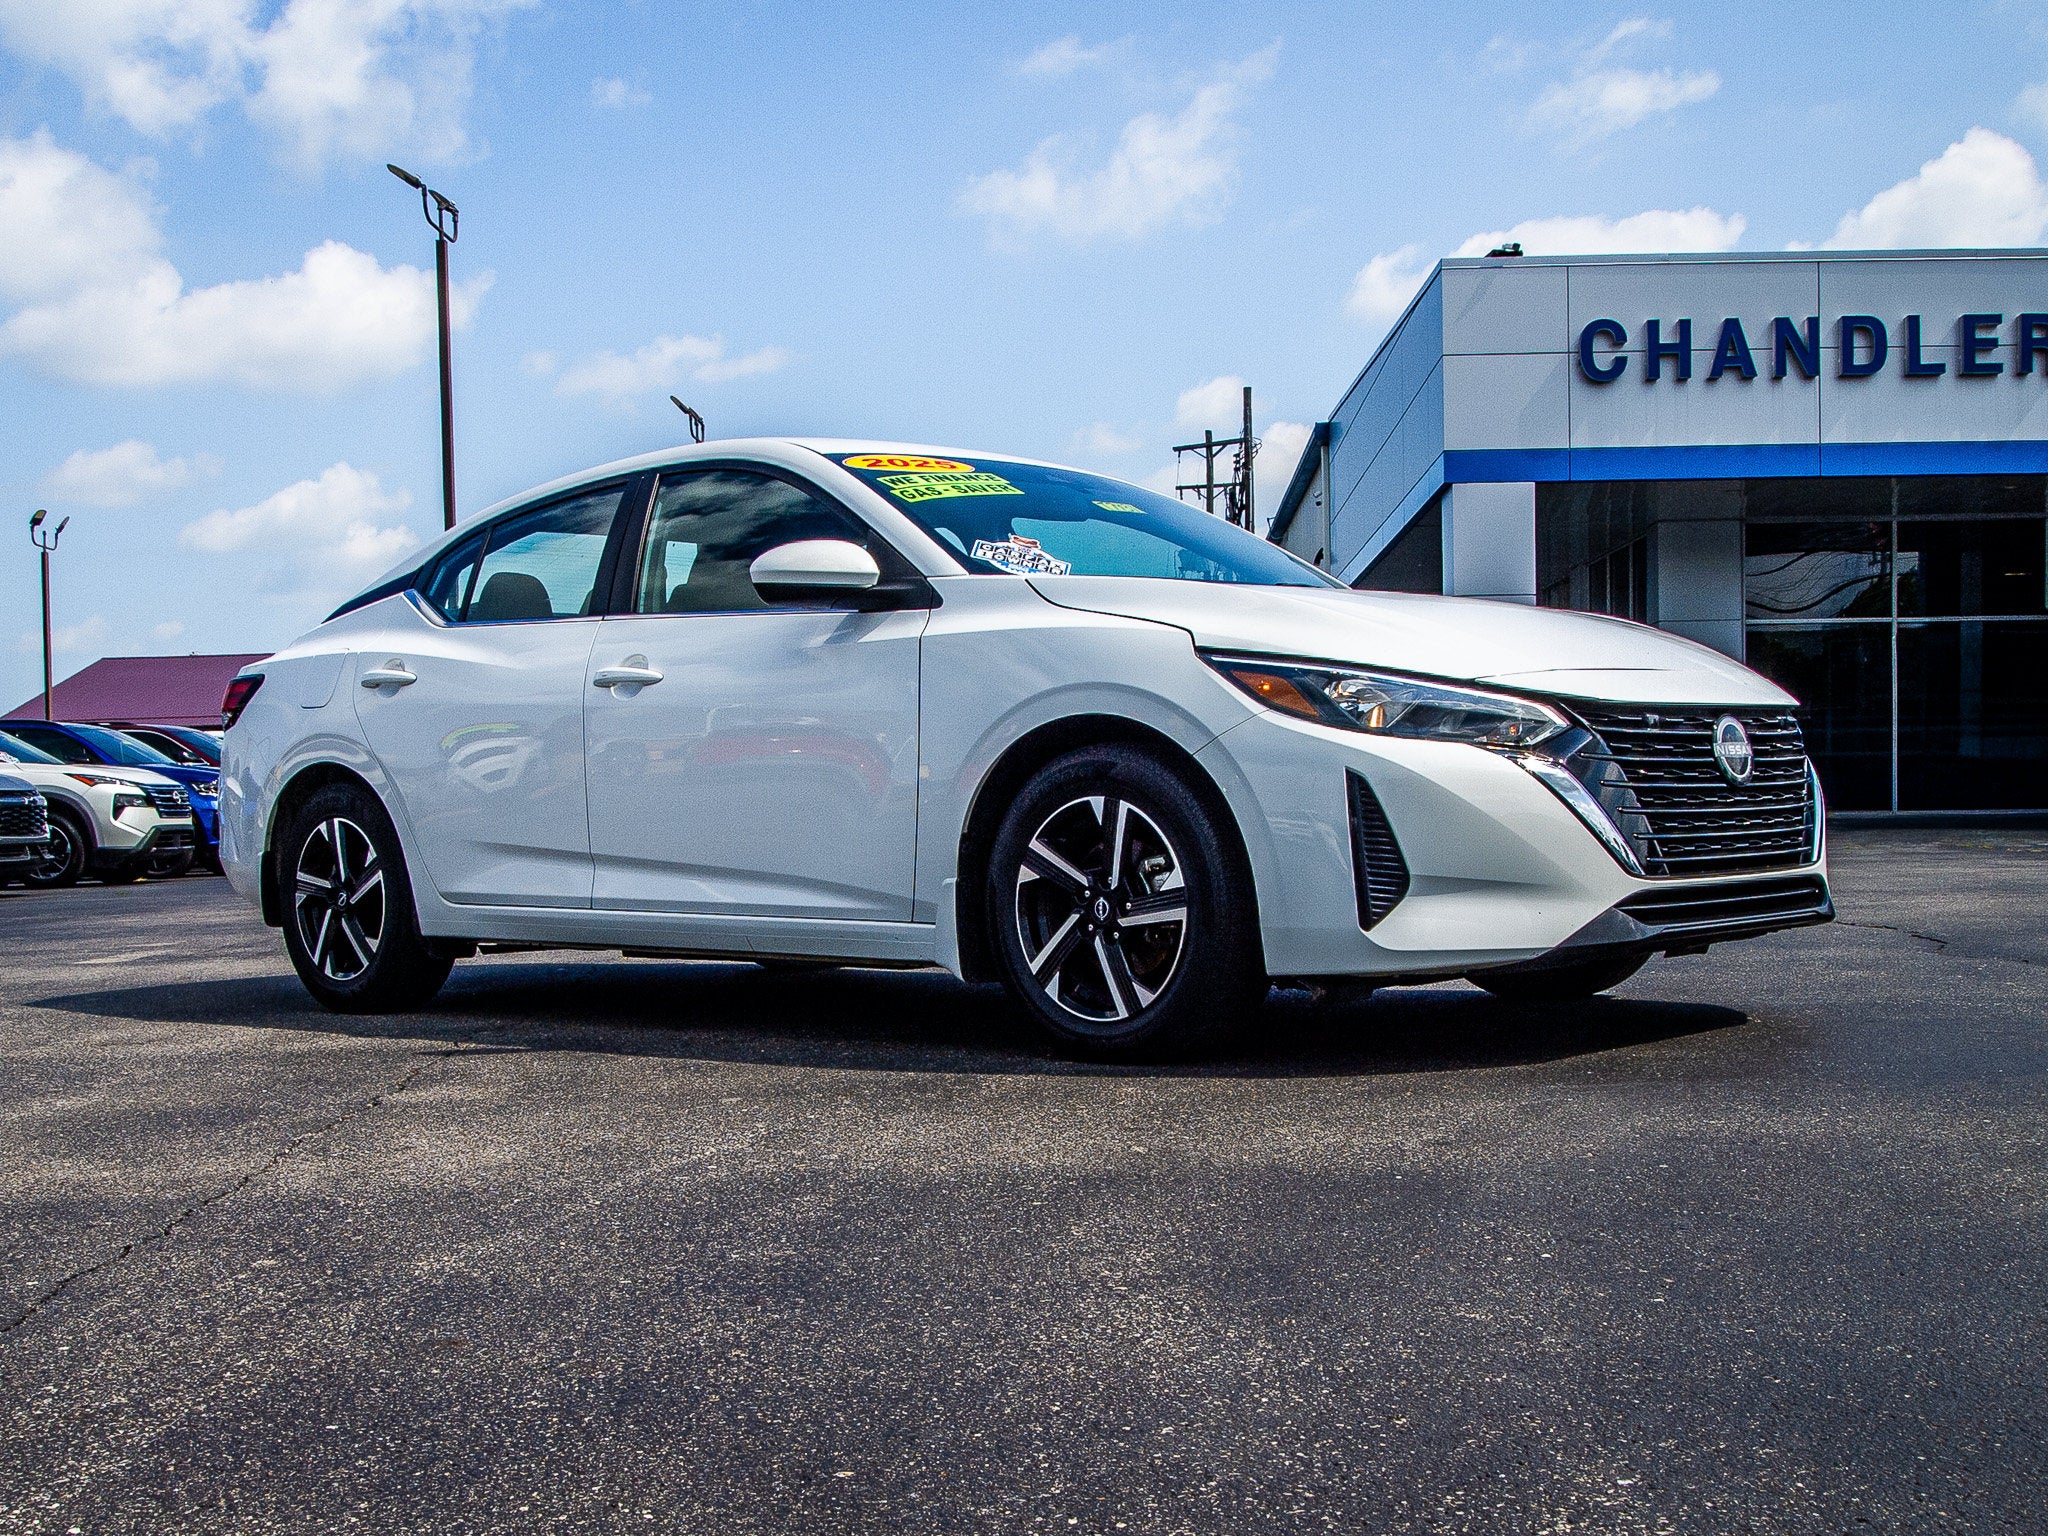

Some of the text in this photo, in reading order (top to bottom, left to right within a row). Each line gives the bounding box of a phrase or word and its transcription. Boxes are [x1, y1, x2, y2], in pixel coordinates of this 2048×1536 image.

[1578, 312, 2048, 383] CHANDLER
[862, 458, 957, 470] 2025
[884, 473, 1001, 487] WE FINANCE
